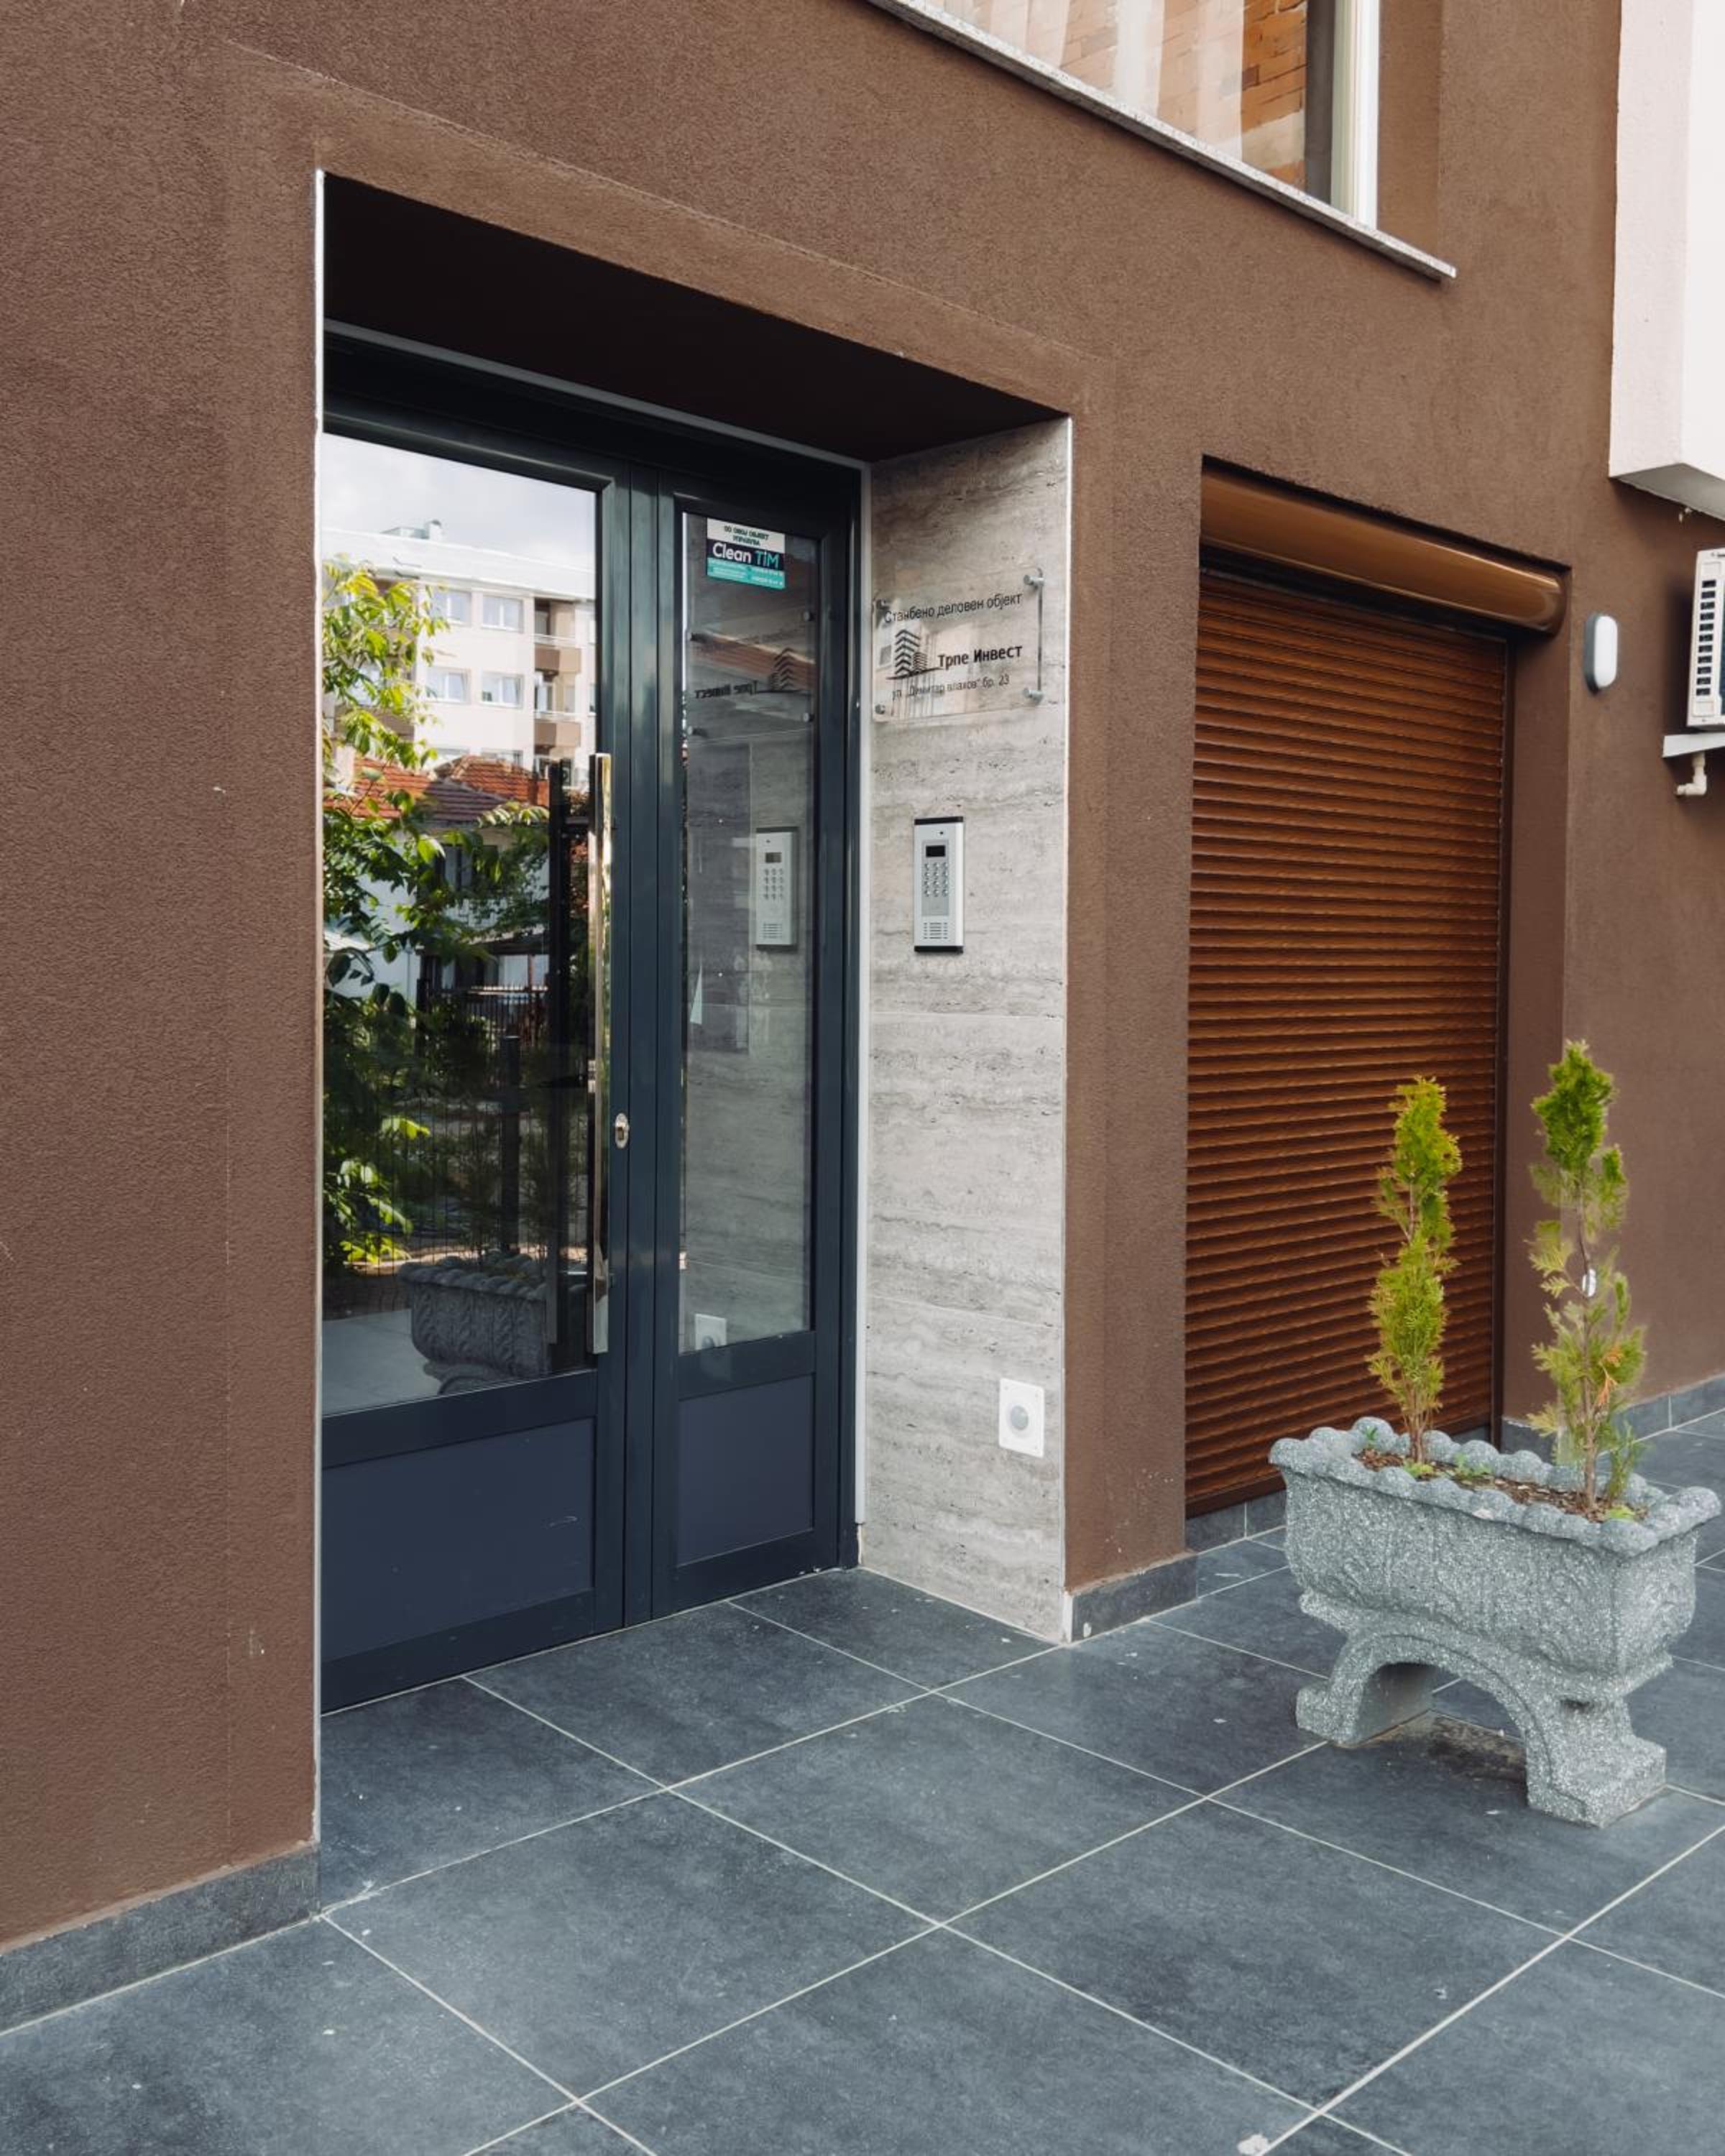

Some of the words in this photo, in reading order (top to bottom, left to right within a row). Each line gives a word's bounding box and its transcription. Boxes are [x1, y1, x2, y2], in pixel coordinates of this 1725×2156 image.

[712, 542, 752, 564] Clean
[884, 604, 934, 623] Станбено
[937, 600, 985, 617] деловен
[987, 593, 1023, 609] објект
[937, 653, 969, 670] Трпе
[973, 645, 1023, 663] Инвест
[998, 674, 1011, 686] 23
